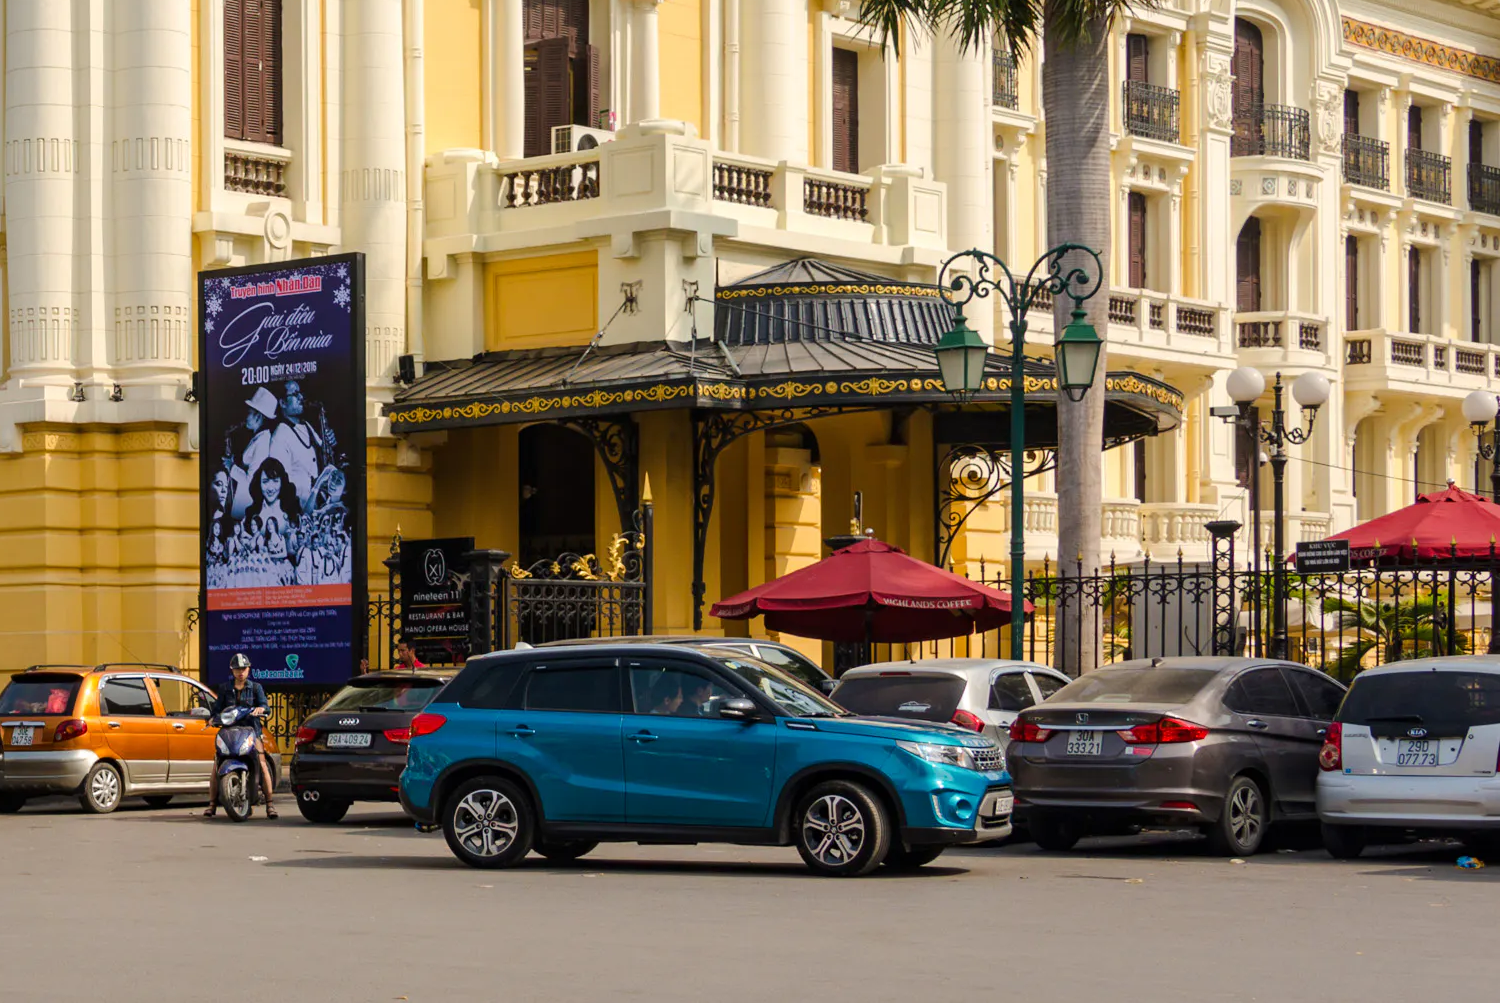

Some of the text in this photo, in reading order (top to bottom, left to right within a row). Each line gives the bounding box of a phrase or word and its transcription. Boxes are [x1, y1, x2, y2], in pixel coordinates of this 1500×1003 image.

[257, 281, 275, 296] hình
[275, 277, 301, 294] Nhân
[301, 274, 322, 291] Dân
[284, 303, 316, 328] điệu
[264, 325, 333, 359] Bốn mùa
[241, 365, 270, 385] 20:00
[413, 592, 449, 602] nineteen
[936, 598, 973, 610] COFFEE
[408, 612, 446, 621] RESTAURANT
[452, 611, 465, 619] BAR
[404, 623, 470, 634] HANOI OPERA HOUSE
[251, 668, 304, 679] Vietcombank
[1076, 730, 1095, 742] 30A
[1067, 742, 1100, 754] 333.21
[1407, 740, 1430, 753] 29D
[1398, 753, 1436, 766] 077.73
